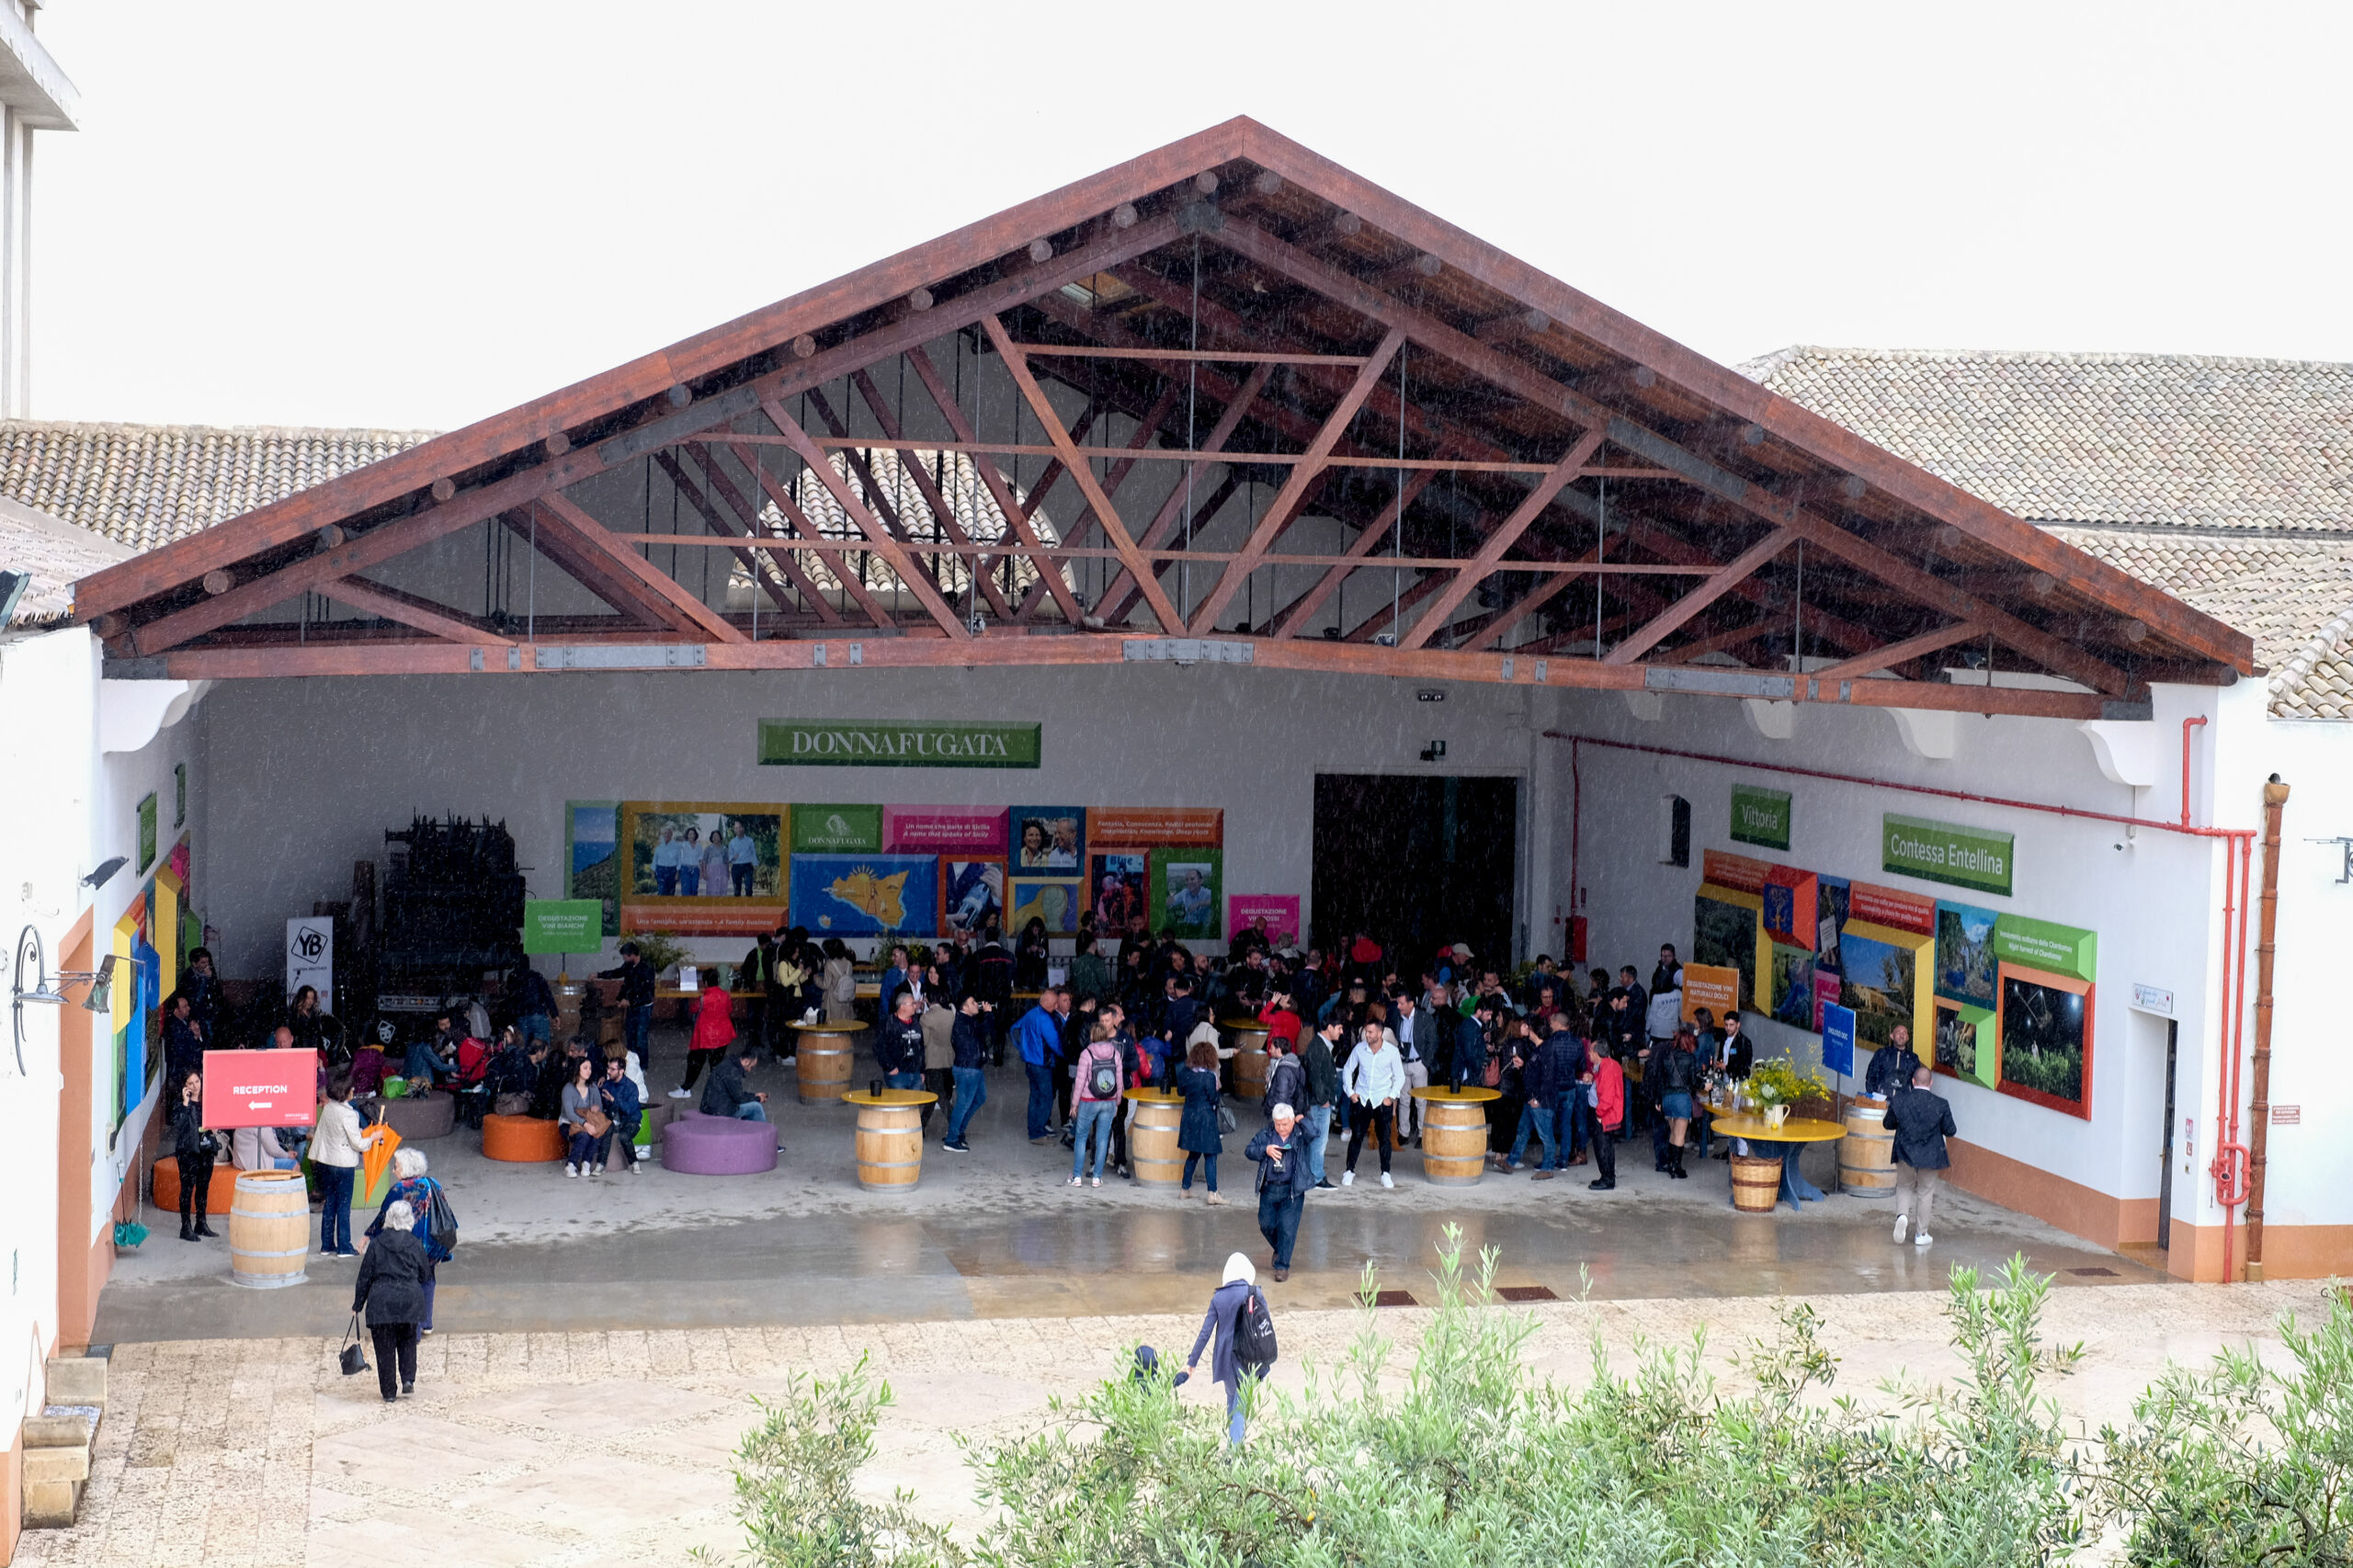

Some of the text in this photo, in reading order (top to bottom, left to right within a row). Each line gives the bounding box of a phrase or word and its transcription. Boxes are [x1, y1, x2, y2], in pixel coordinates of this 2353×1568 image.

[792, 731, 1008, 756] DONNAFUGATA
[1742, 804, 1778, 830] Vittoria
[1110, 856, 1132, 866] Blue
[1891, 834, 2003, 876] Contessa Entellina
[726, 918, 745, 926] family
[299, 934, 322, 956] YB
[1686, 980, 1722, 992] DEGUSTAZIONE
[1689, 989, 1729, 1001] NATURALI DOLCI
[233, 1085, 288, 1095] RECEPTION
